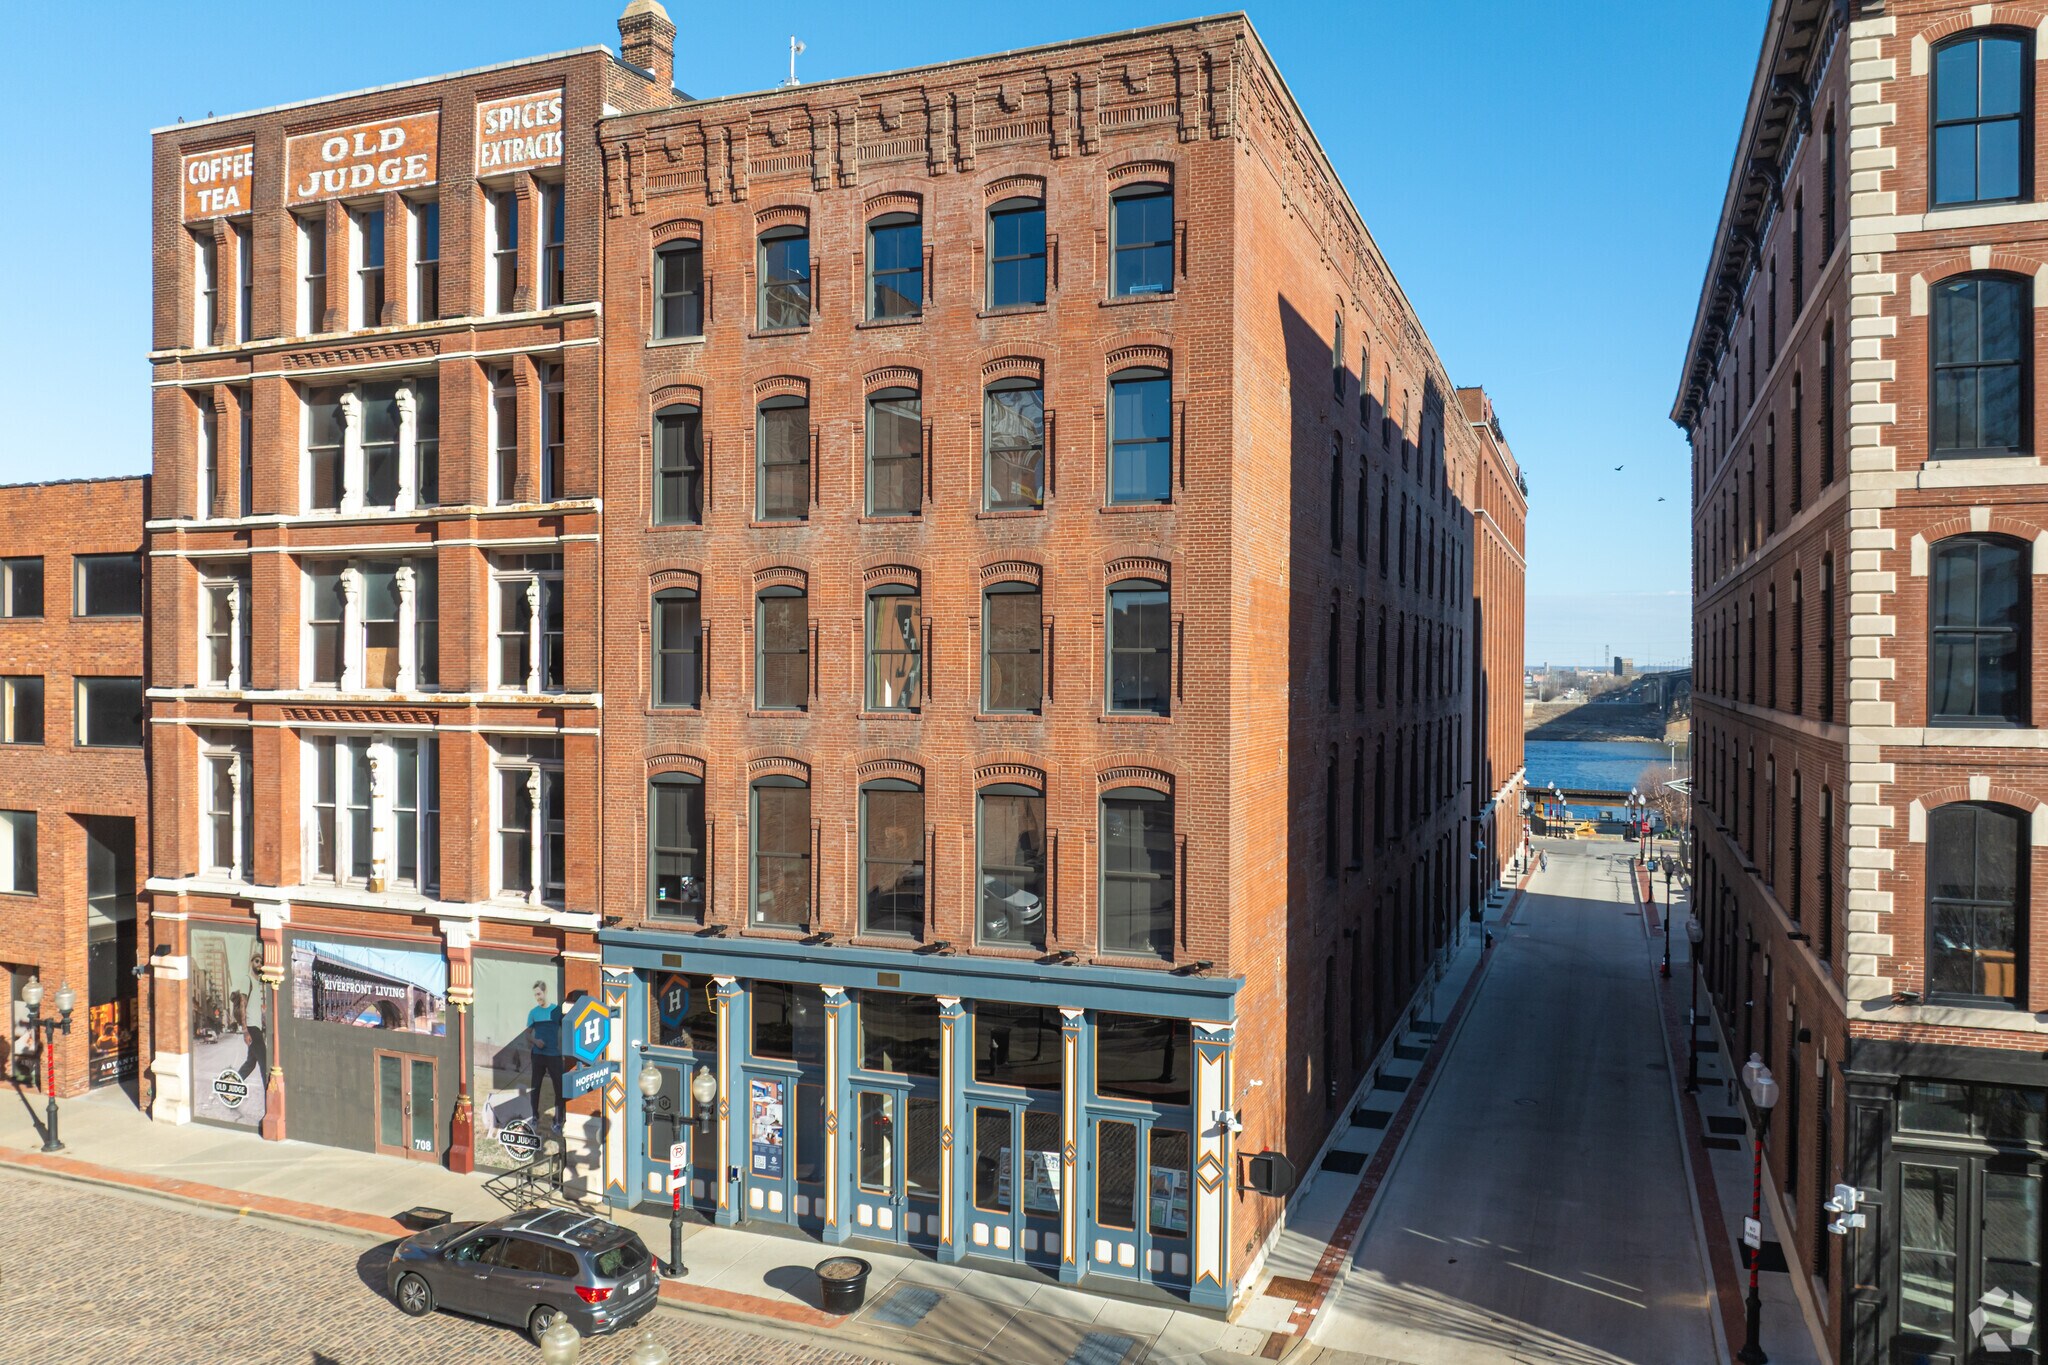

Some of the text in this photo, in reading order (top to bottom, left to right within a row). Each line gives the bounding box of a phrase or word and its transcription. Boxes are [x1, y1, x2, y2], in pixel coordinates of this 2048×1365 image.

[485, 97, 563, 135] SPICES
[321, 127, 406, 162] OLD
[481, 130, 564, 168] EXTRACTS
[188, 152, 254, 185] COFFEE
[298, 153, 428, 197] JUDGE
[197, 185, 240, 212] TEA
[324, 980, 405, 998] RIVERFRONT LIVING
[584, 1017, 600, 1045] H
[215, 1082, 246, 1095] OLD JUDGE
[575, 1067, 609, 1087] HOFFMAN
[581, 1078, 604, 1092] LOFTS
[415, 1139, 431, 1151] 708
[502, 1133, 538, 1147] OLD JUDGE
